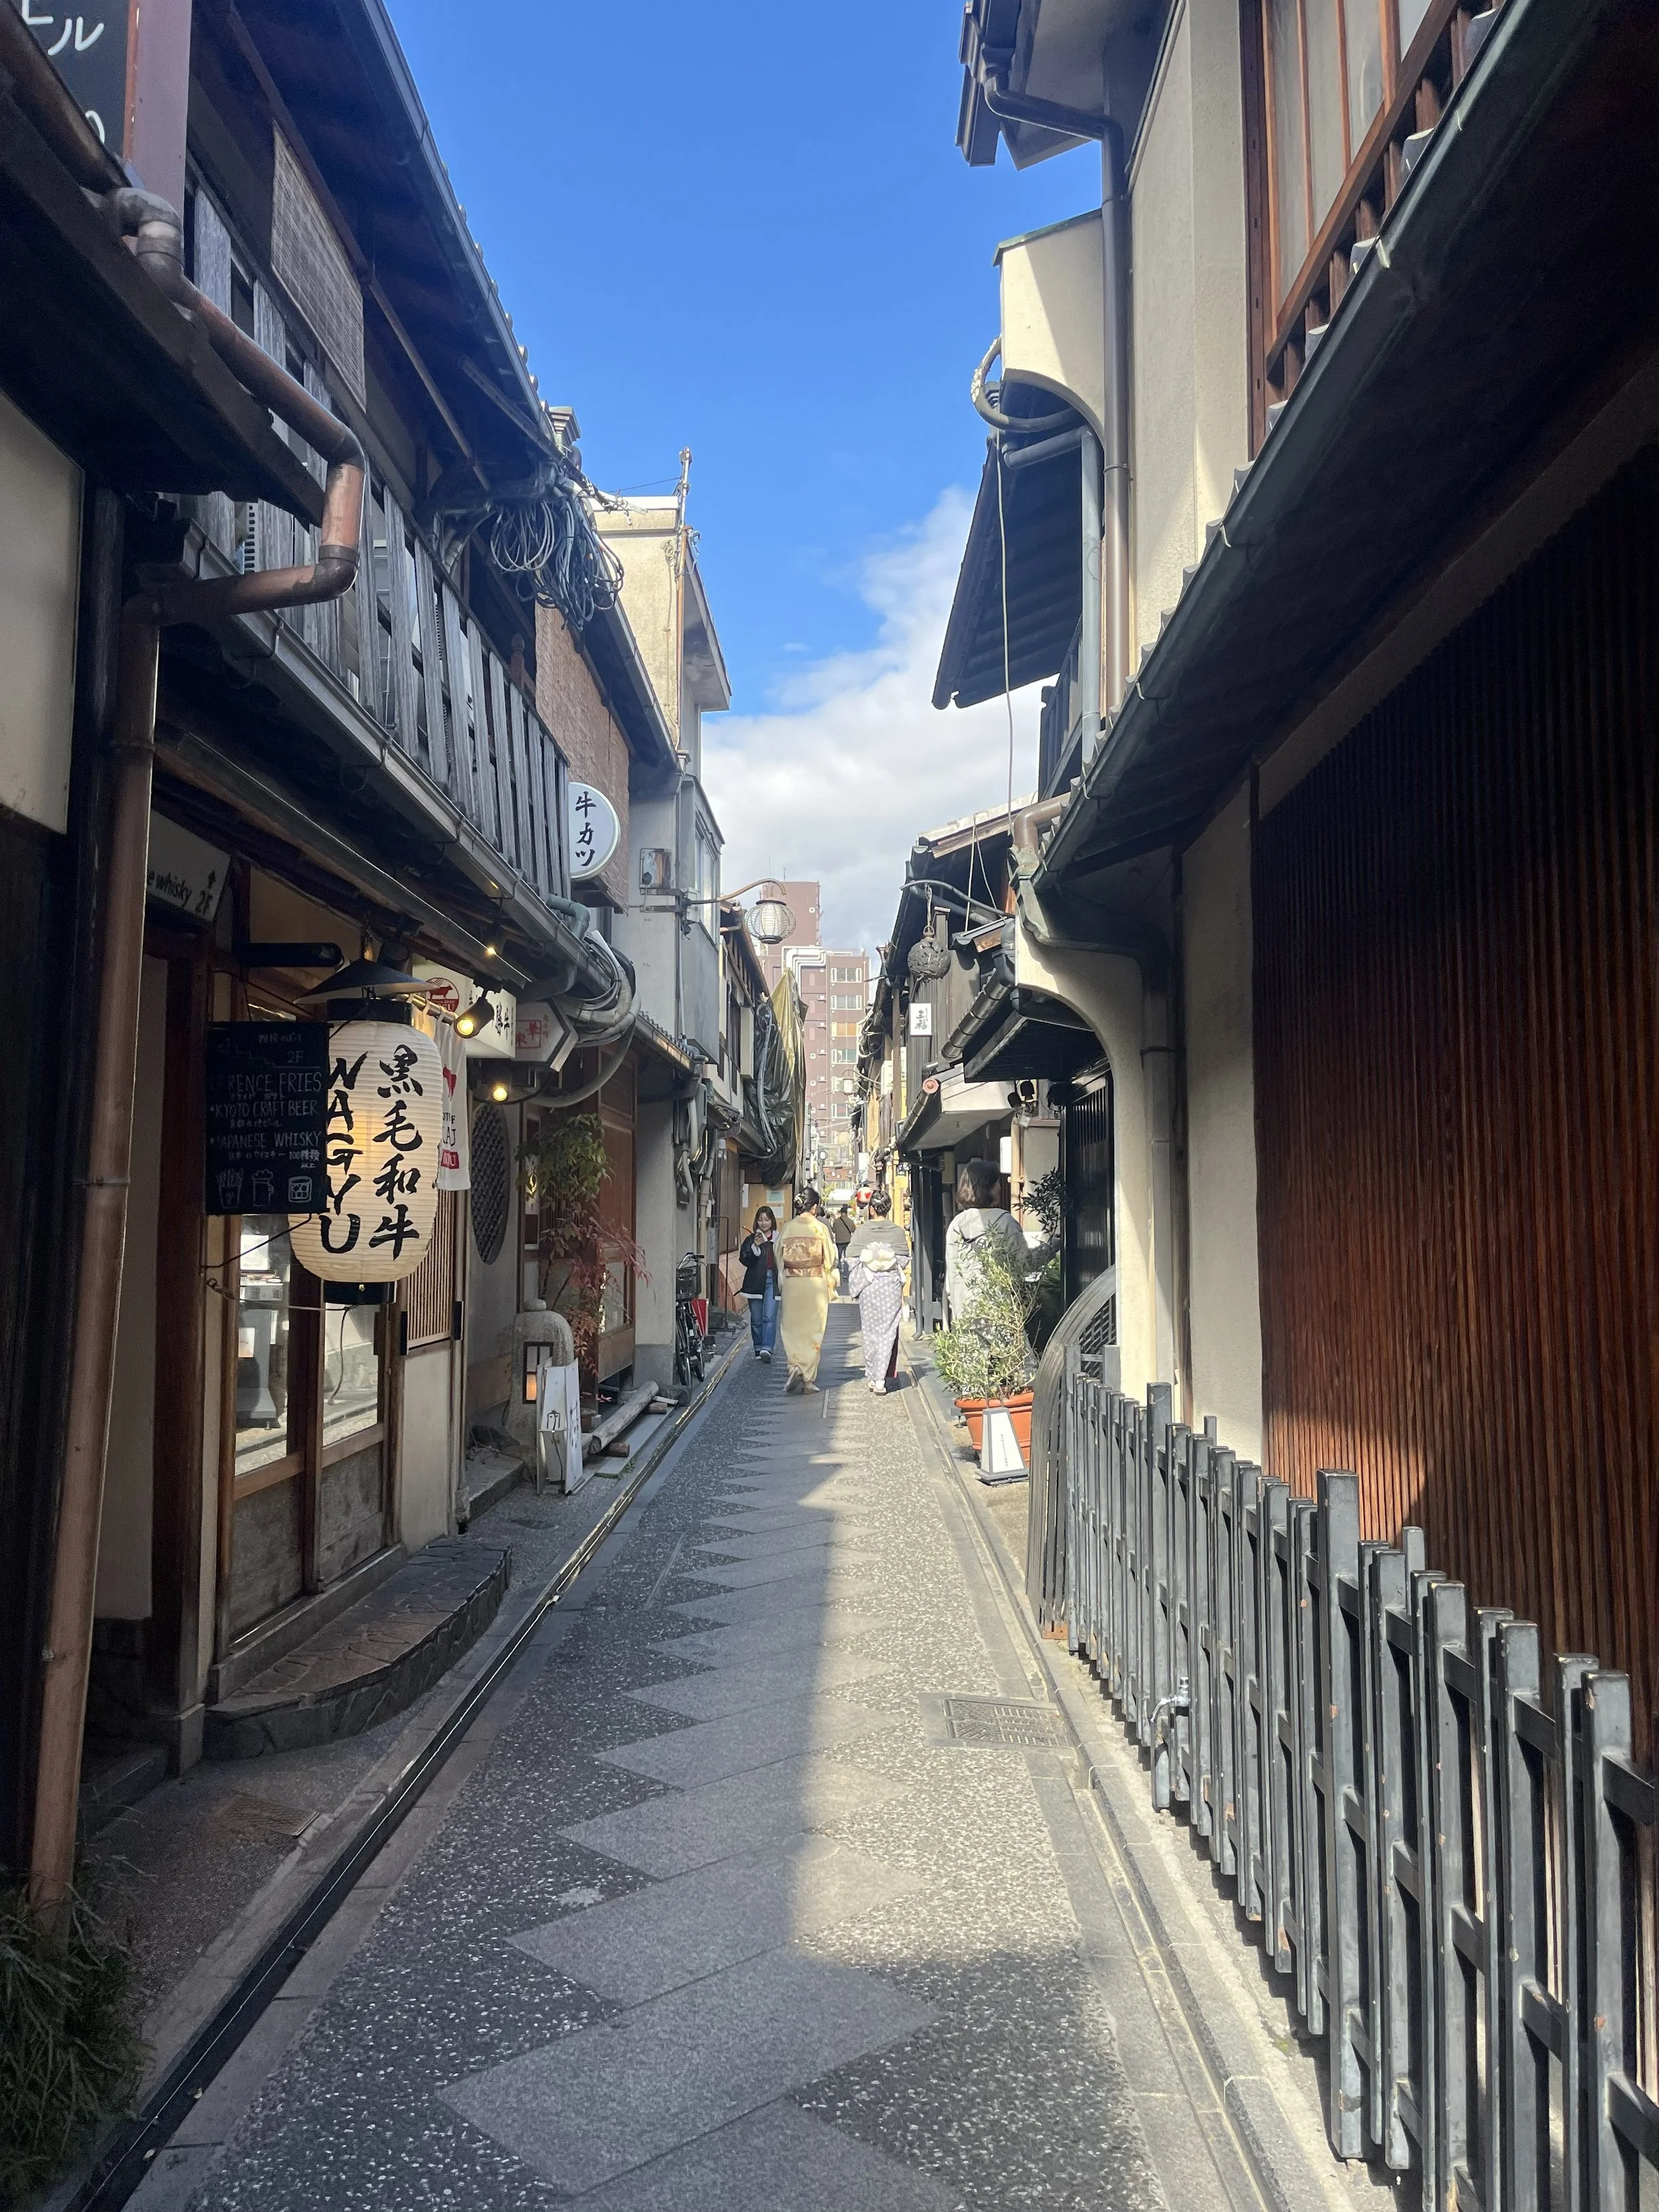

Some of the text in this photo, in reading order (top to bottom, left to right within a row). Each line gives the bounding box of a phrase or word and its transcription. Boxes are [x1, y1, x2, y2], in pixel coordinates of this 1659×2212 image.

[575, 791, 596, 866] 牛カツ
[287, 1051, 304, 1063] 2F
[279, 1072, 322, 1094] FRIES
[216, 1100, 319, 1118] KYOTO CRAFT BEER
[274, 1130, 322, 1147] WHISKY
[368, 1044, 423, 1260] 黒毛和牛
